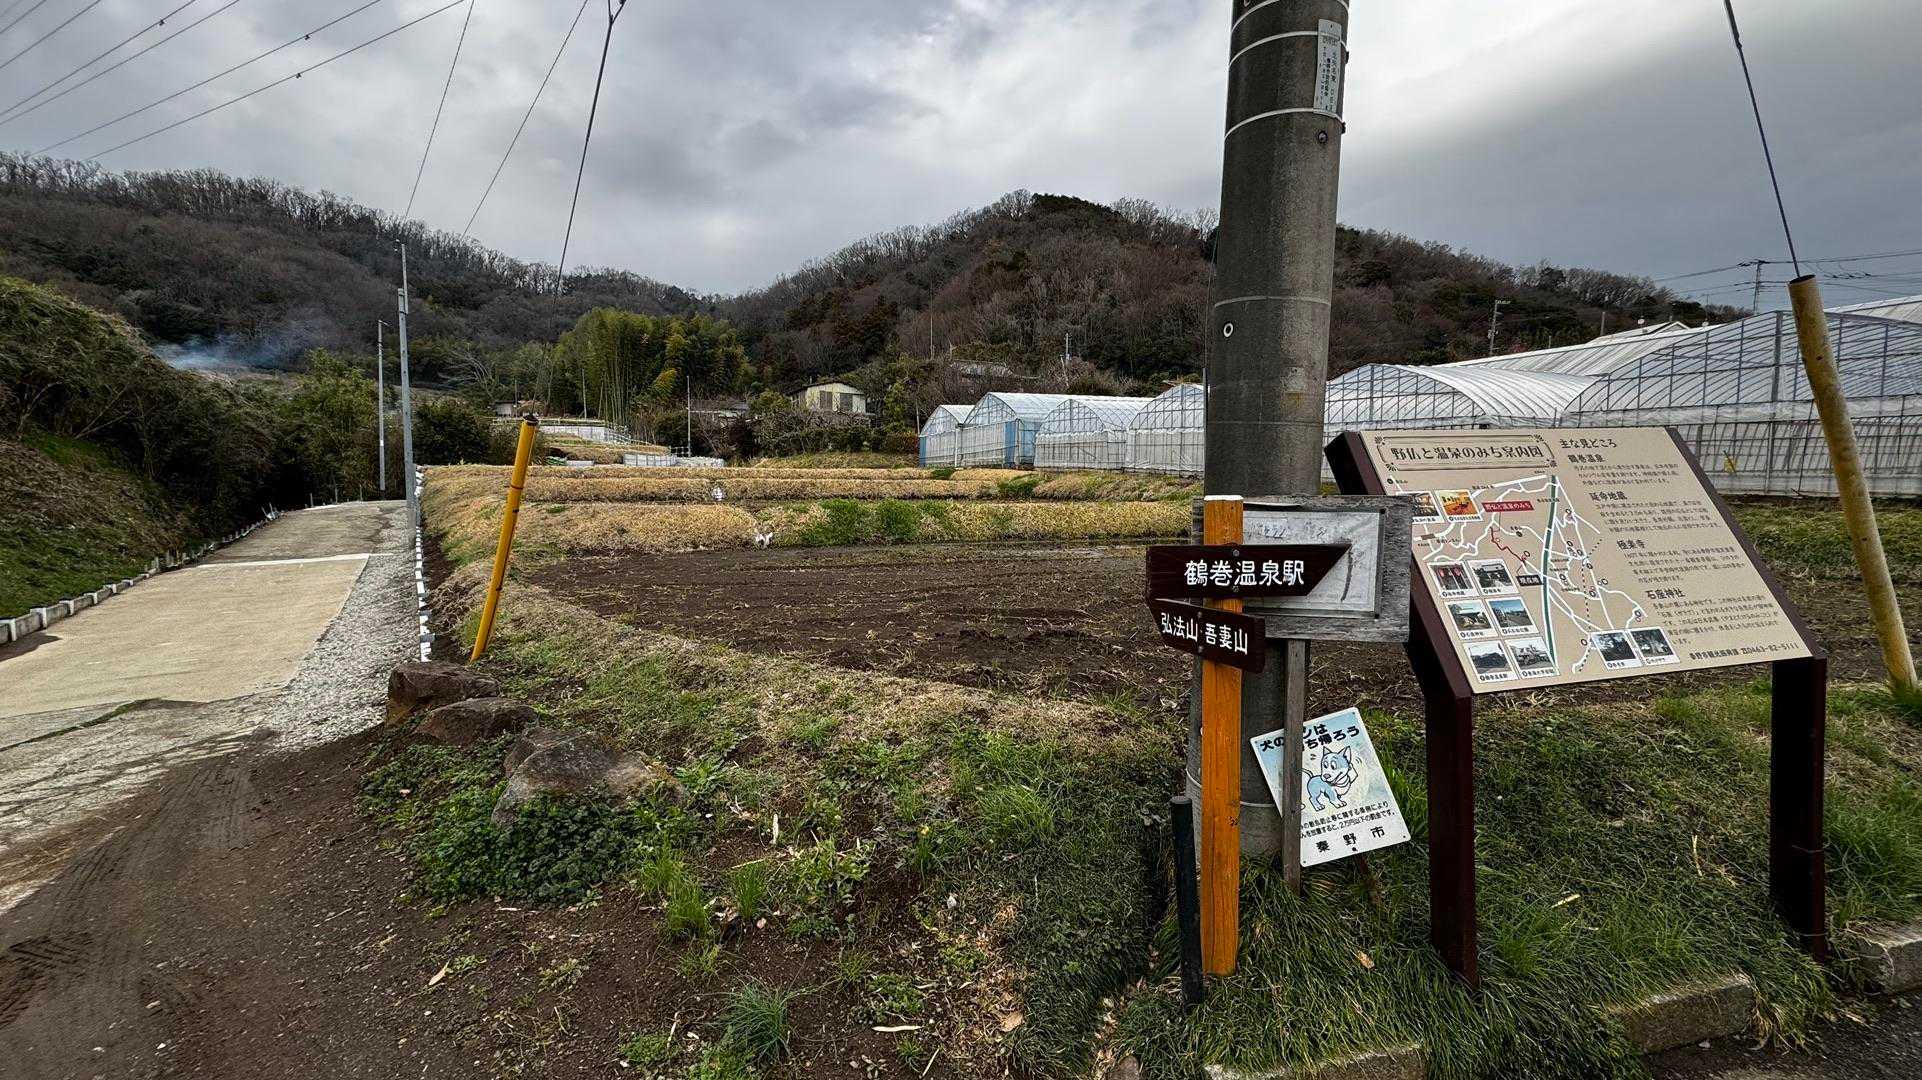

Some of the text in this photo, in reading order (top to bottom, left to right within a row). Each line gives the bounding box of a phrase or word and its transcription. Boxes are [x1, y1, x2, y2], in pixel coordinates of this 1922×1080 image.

[1391, 445, 1544, 460] 野仏と温泉のみち案内図
[1560, 438, 1617, 449] 主な見どころ
[1184, 559, 1305, 587] 鶴巻温泉駅
[1645, 587, 1685, 600] 石座神社
[1160, 611, 1249, 656] 弘法山 吾妻山
[1260, 723, 1328, 751] 犬のンは
[1302, 725, 1360, 751] ち帰ろう
